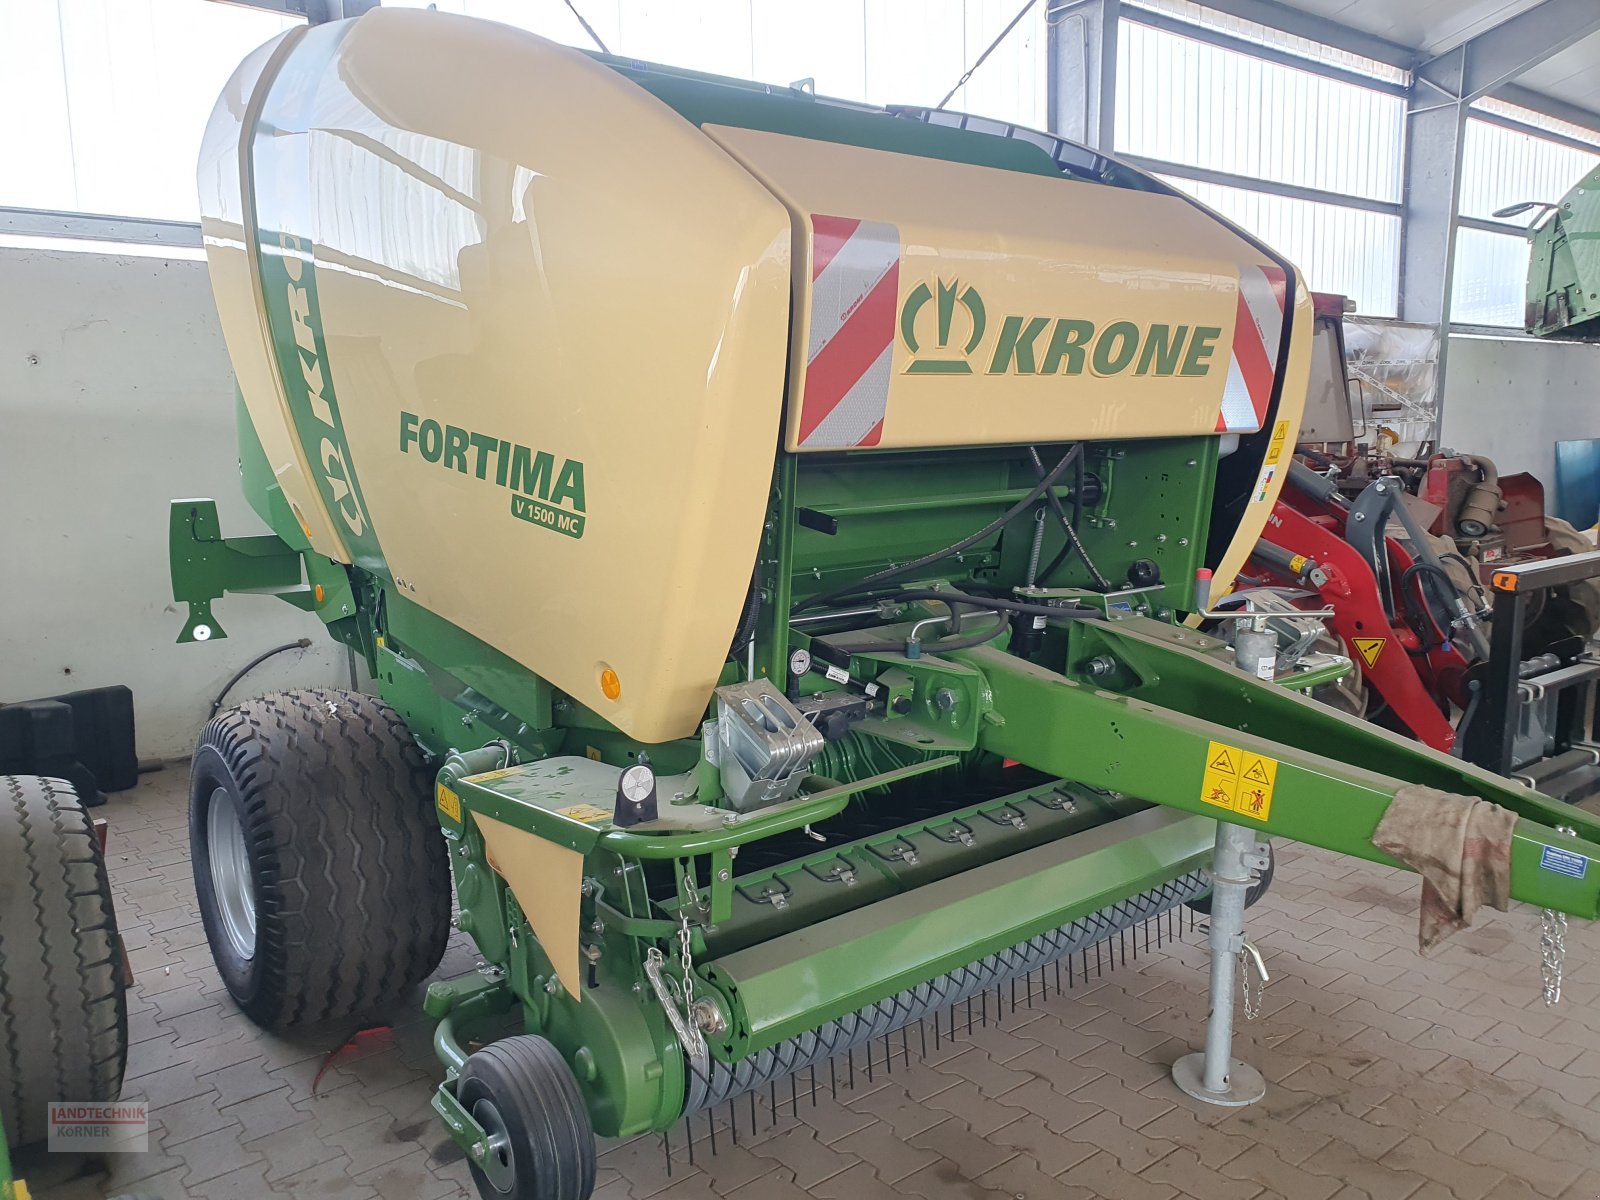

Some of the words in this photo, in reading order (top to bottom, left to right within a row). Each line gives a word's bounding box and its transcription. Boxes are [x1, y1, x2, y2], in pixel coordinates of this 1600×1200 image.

[986, 314, 1222, 376] KRONE
[400, 410, 586, 513] FORTIMA
[515, 499, 525, 514] V
[527, 504, 555, 525] 1500
[557, 514, 579, 533] MC
